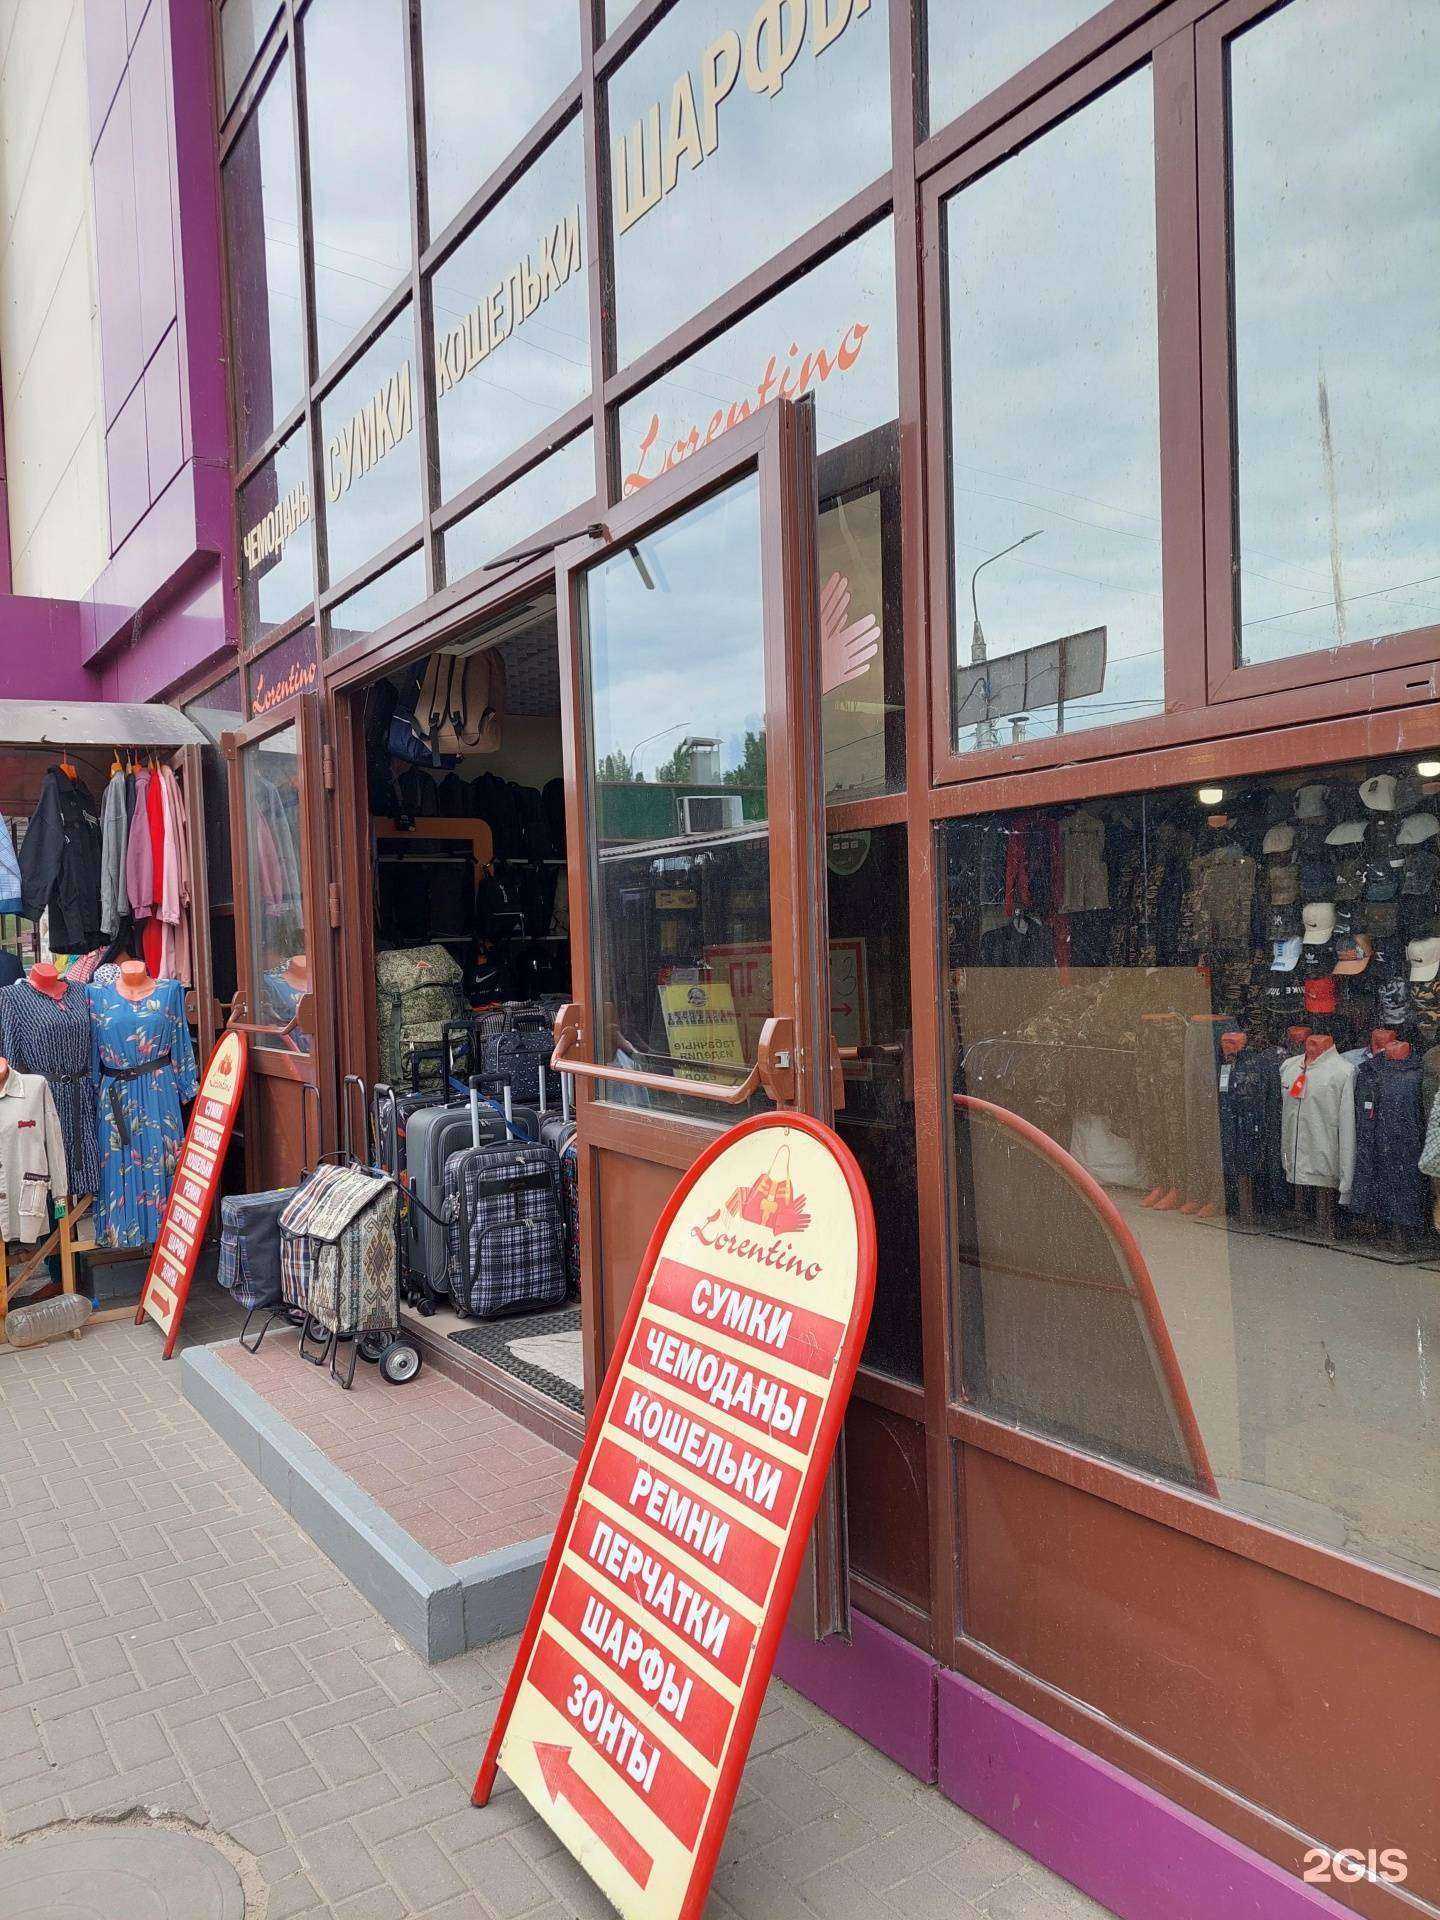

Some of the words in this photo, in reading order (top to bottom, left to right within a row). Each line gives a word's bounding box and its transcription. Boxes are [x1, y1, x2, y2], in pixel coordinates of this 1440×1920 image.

[436, 204, 582, 398] КОШЕЛЬКИ
[324, 360, 413, 503] СУМКИ
[624, 322, 870, 496] Lorentino
[252, 661, 317, 713] Lorentino
[690, 1208, 824, 1282] Lorentino
[691, 1278, 793, 1350] СУМКИ
[645, 1328, 807, 1438] ЧЕМОДАНЫ
[624, 1391, 783, 1512] КОШЕЛЬКИ
[628, 1468, 730, 1565] РЕМНИ
[588, 1519, 731, 1659] ПЕРЧАТКИ
[580, 1595, 694, 1722] ШАРФЫ
[566, 1674, 661, 1794] ЗОНТЫ
